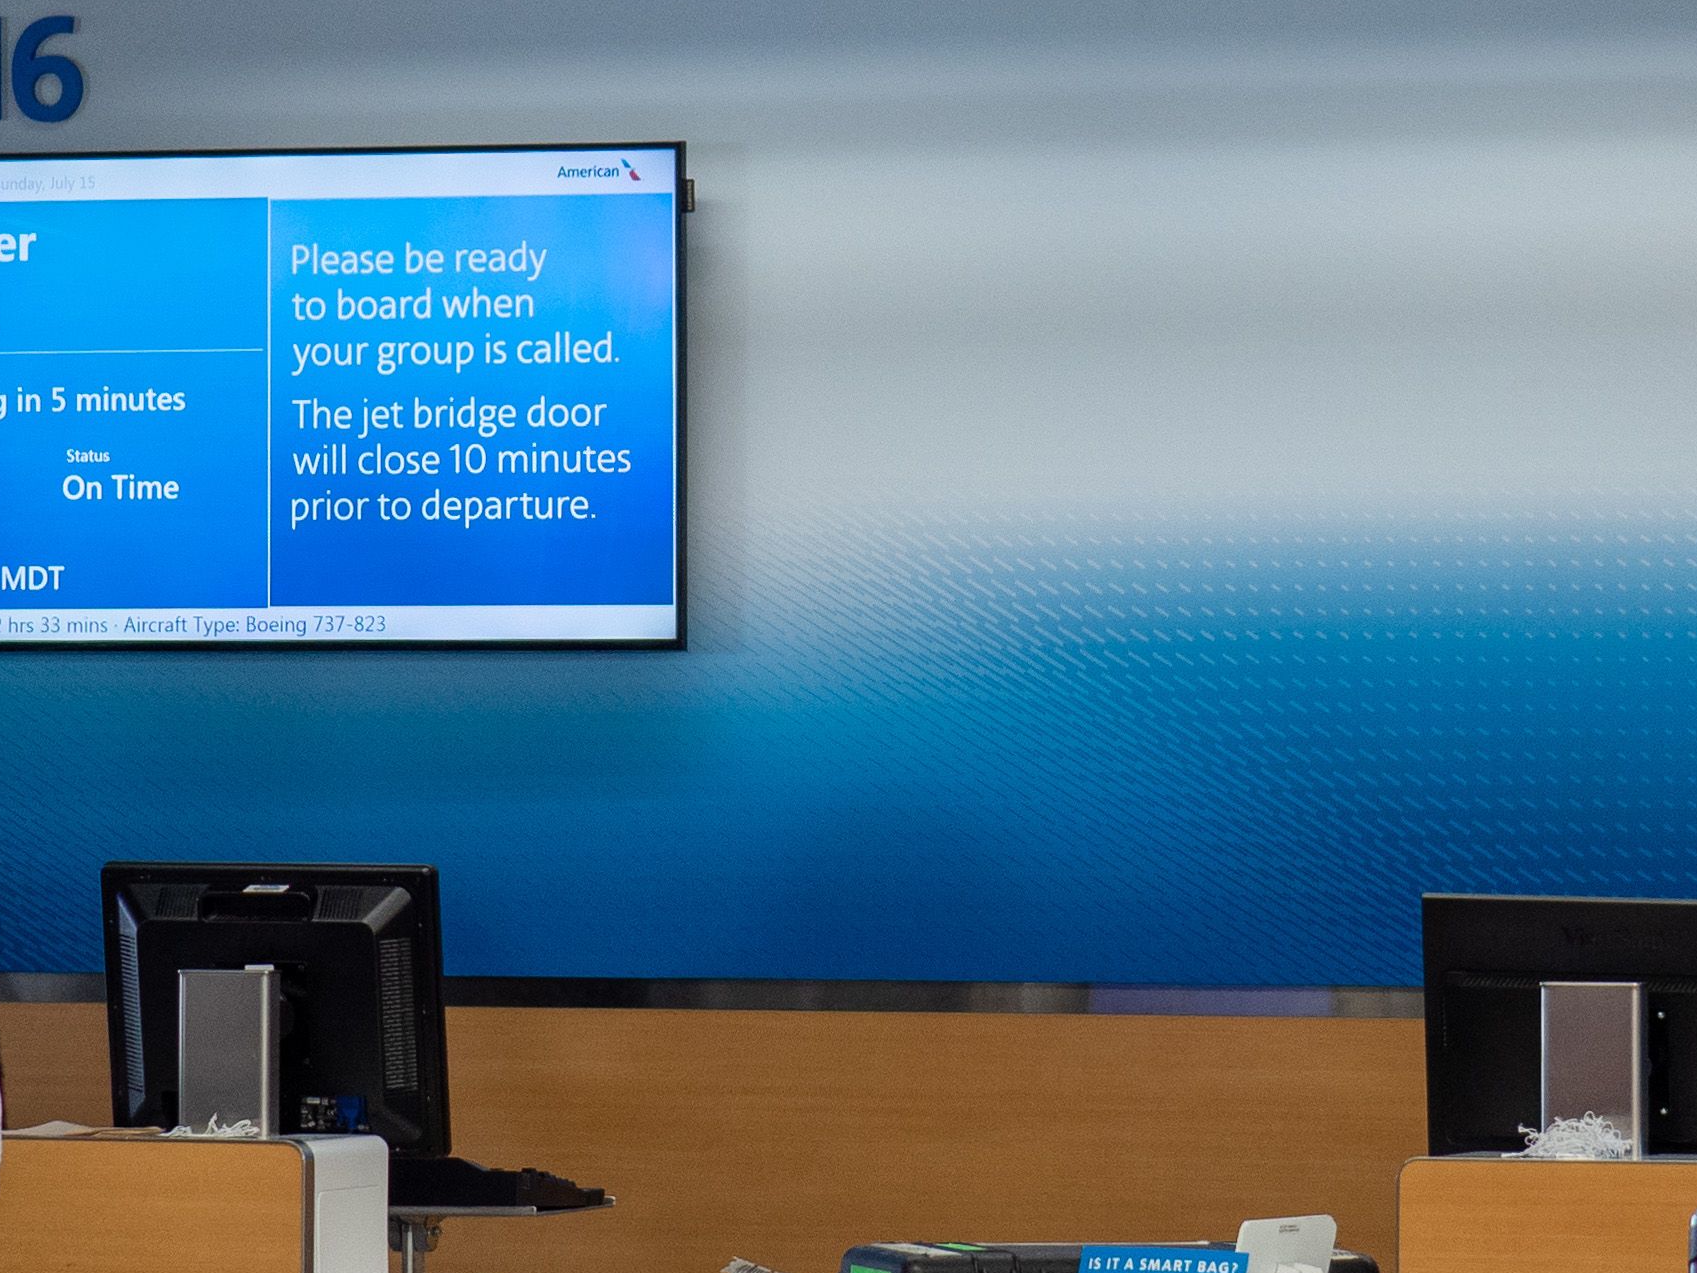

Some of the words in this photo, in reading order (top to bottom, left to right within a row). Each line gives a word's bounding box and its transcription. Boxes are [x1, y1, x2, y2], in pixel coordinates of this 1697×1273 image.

[556, 164, 620, 179] American
[291, 243, 395, 275] Please
[405, 241, 445, 274] be
[455, 240, 548, 281] ready
[291, 293, 327, 321] to
[337, 287, 432, 320] board
[442, 286, 535, 318] when
[291, 341, 369, 376] your
[377, 338, 475, 375] group
[484, 333, 507, 365] is
[516, 331, 620, 364] called.
[17, 386, 42, 414] in
[51, 385, 67, 413] 5
[76, 384, 186, 413] minutes
[292, 399, 353, 430] The
[358, 399, 404, 439] jet
[413, 396, 516, 438] bridge
[526, 395, 607, 428] door
[66, 448, 111, 465] Status
[292, 444, 348, 476] will
[358, 443, 441, 475] close
[449, 442, 486, 474] 10
[498, 442, 632, 474] minutes
[62, 474, 103, 501] On
[111, 473, 180, 500] Time
[291, 490, 370, 530] prior
[377, 495, 412, 521] to
[421, 488, 597, 529] departure.
[1, 565, 65, 591] MDT
[7, 615, 34, 634] hrs
[40, 616, 61, 634] 33
[67, 615, 108, 633] mins
[123, 614, 188, 635] Aircraft
[193, 615, 240, 639] Type:
[246, 615, 307, 638] Boeing
[313, 614, 387, 633] 737-823
[1088, 1257, 1102, 1270] IS
[1106, 1257, 1121, 1270] IT
[1124, 1257, 1134, 1271] A
[1139, 1258, 1192, 1273] SMART
